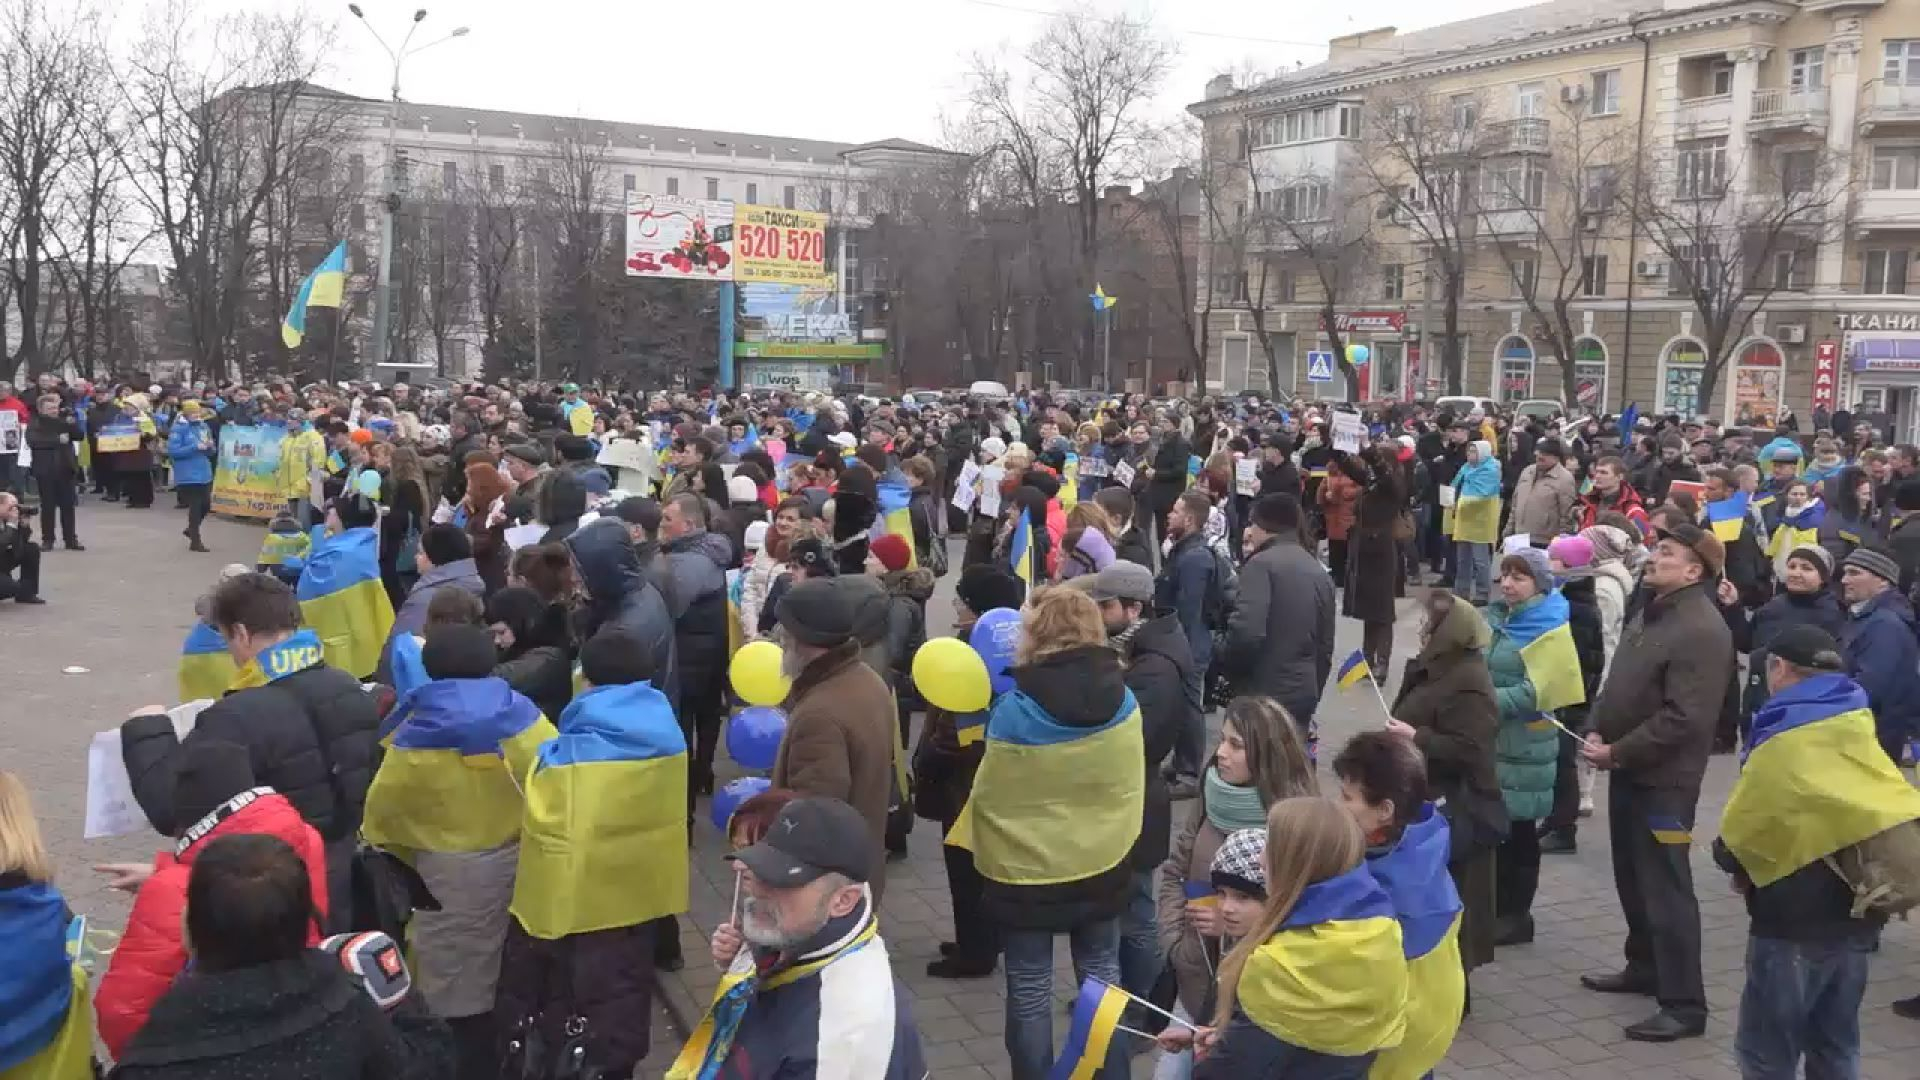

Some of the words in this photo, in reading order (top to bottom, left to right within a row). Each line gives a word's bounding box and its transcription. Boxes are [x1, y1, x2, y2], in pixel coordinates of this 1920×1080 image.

[765, 210, 800, 229] ТАКСИ
[740, 224, 780, 258] 520
[787, 229, 824, 263] 520
